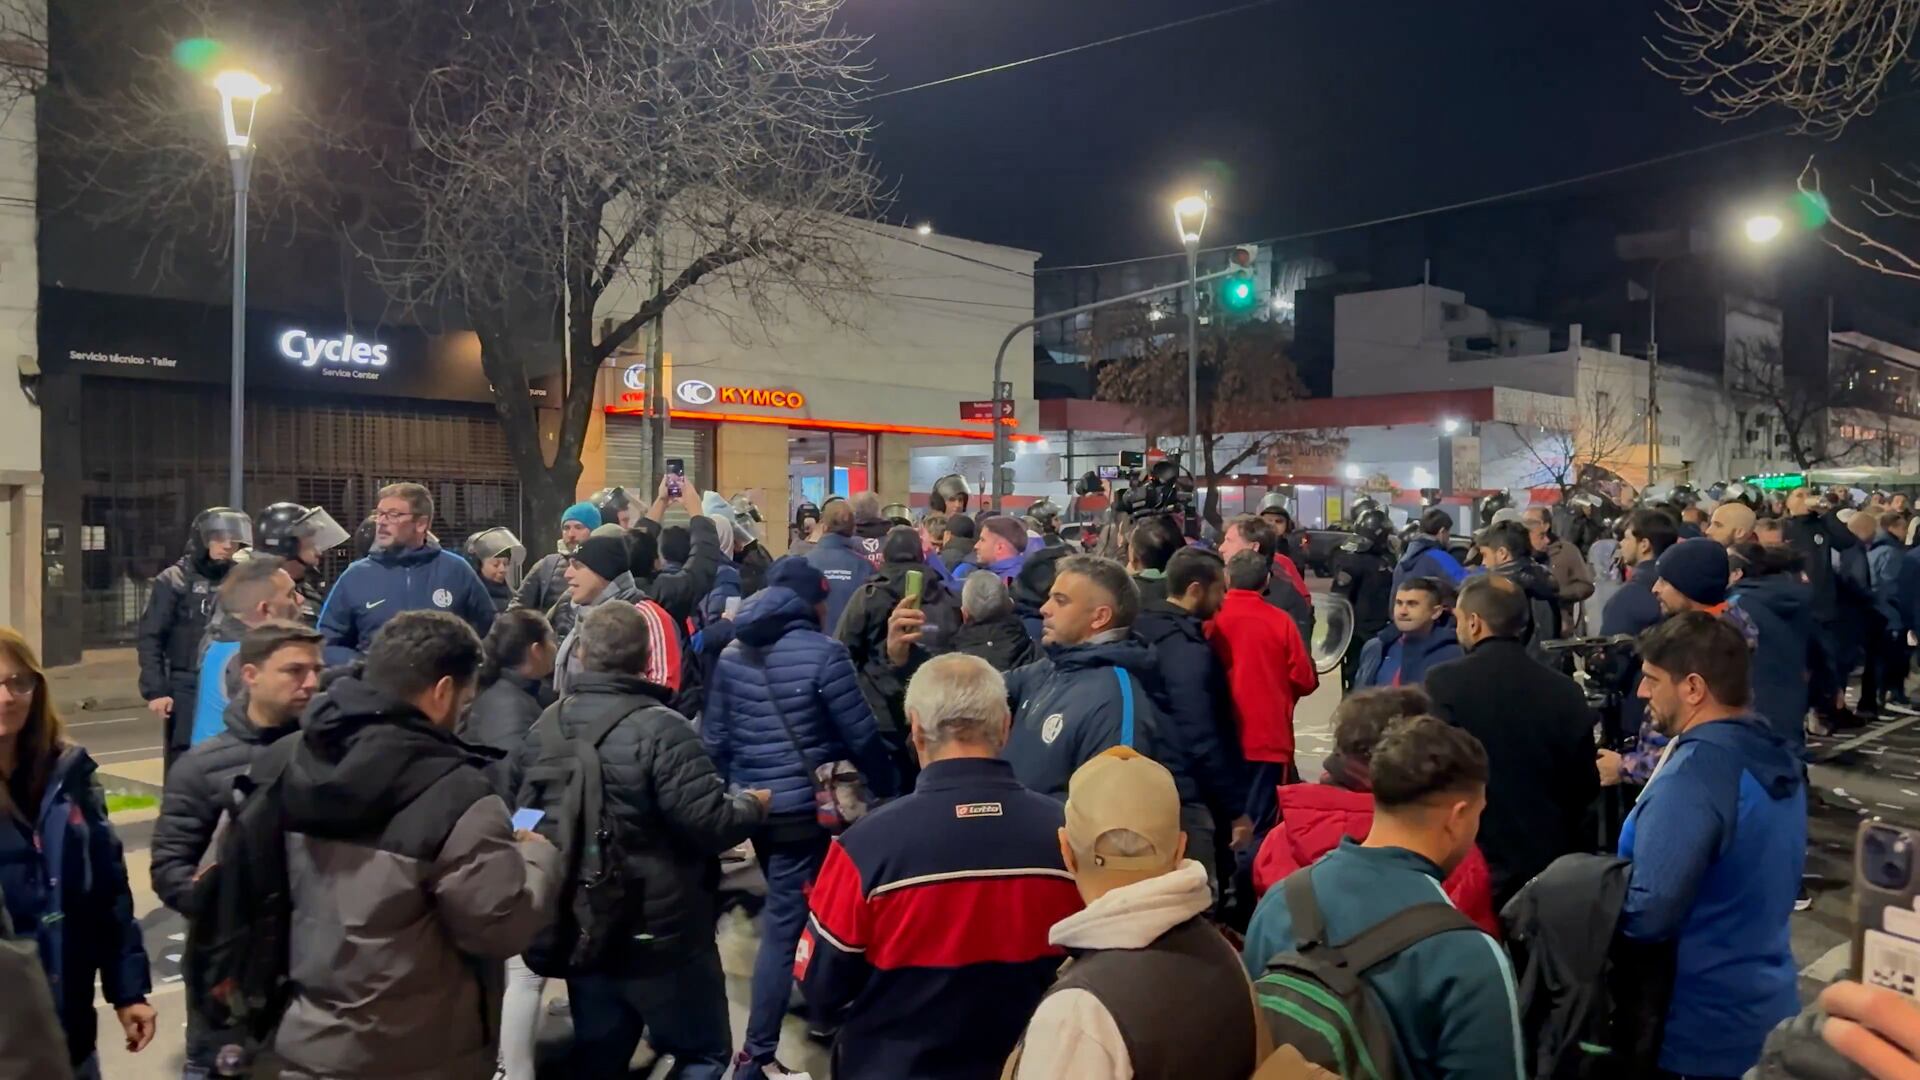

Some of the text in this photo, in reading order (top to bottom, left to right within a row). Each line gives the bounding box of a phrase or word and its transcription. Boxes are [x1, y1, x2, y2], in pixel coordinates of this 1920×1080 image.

[280, 329, 388, 367] Cycles
[69, 350, 108, 362] Servicio
[109, 354, 144, 365] técnico
[151, 357, 177, 367] Taller
[322, 368, 380, 380] Service Center
[719, 386, 804, 408] KYMCO
